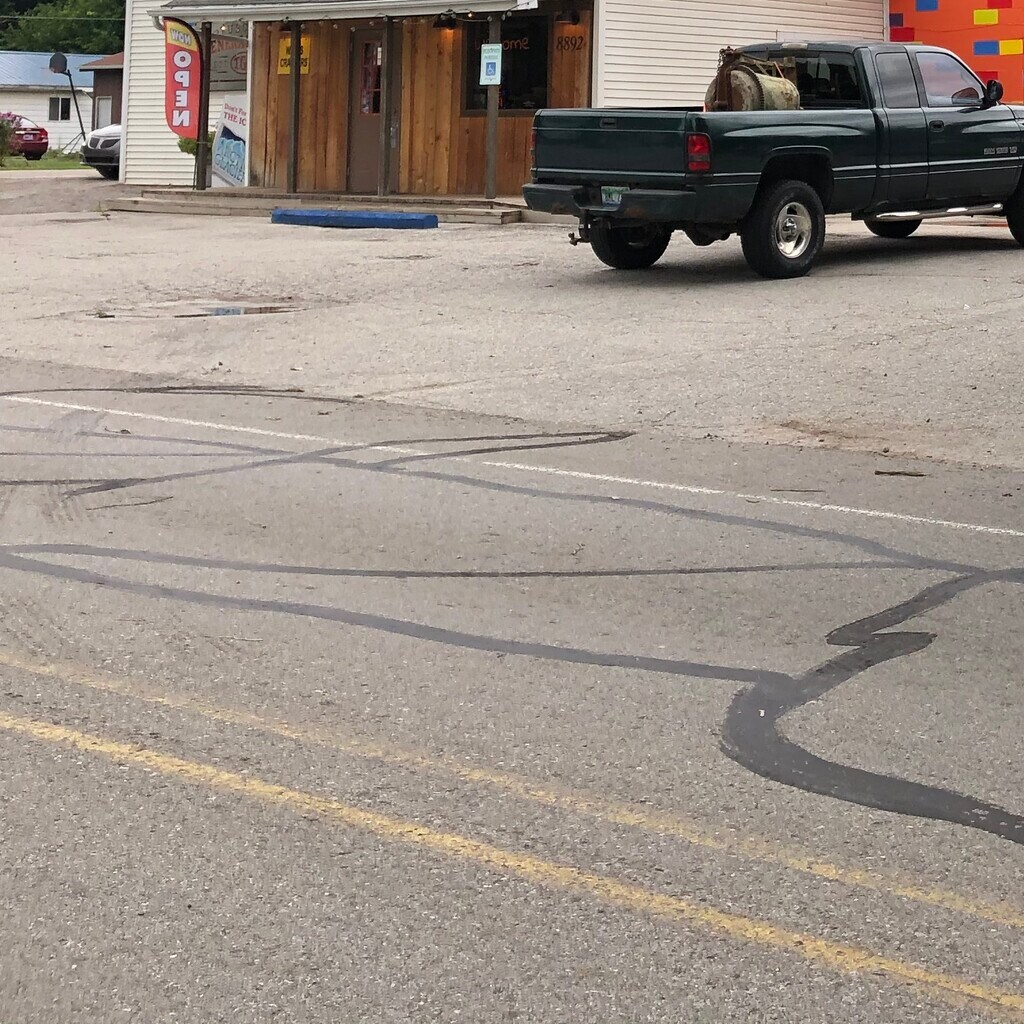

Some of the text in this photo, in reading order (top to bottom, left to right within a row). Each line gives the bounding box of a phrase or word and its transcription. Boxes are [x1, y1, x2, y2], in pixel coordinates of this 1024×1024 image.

[556, 36, 584, 51] 8892
[224, 103, 238, 114] Don't
[224, 112, 247, 126] THE IC
